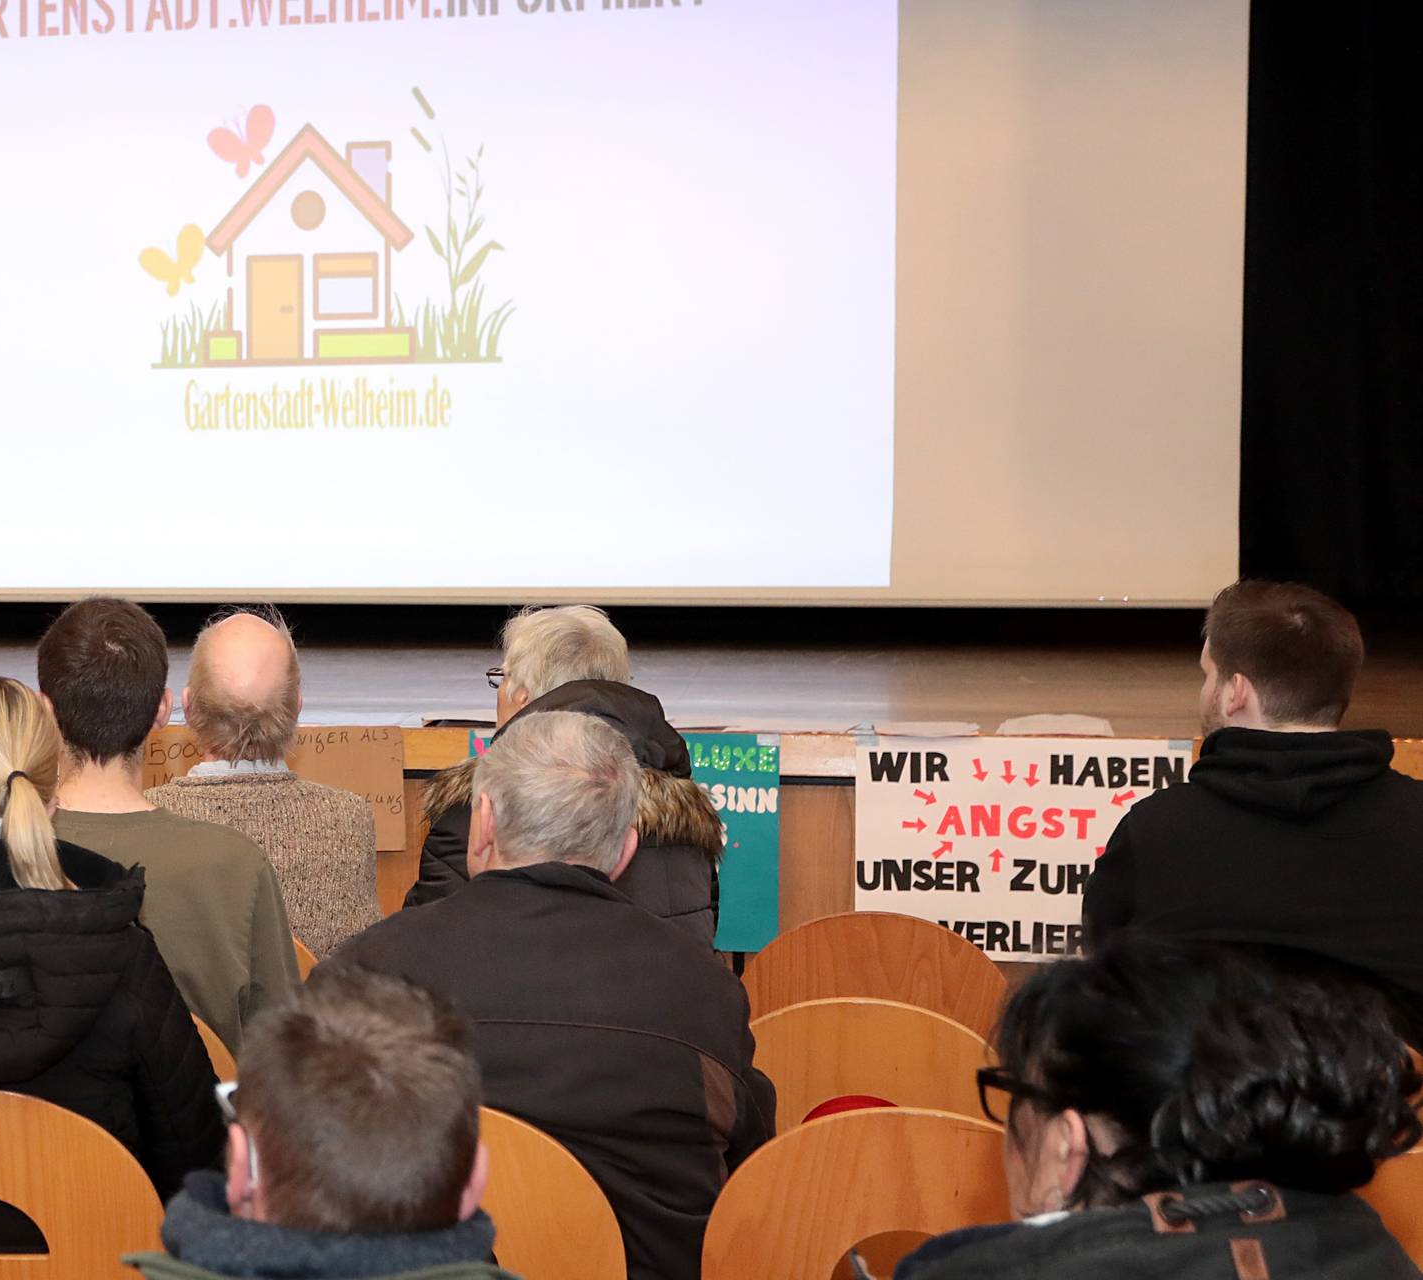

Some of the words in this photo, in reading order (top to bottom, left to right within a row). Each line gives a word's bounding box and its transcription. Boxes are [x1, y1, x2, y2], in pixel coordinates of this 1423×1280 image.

[184, 375, 452, 432] Gartenstadt-Welheim.de
[360, 728, 390, 742] ALS
[686, 742, 777, 773] LUXE
[869, 751, 950, 784] WIR
[1050, 754, 1185, 789] HABEN
[698, 783, 778, 814] SINN
[936, 804, 1097, 840] ANGST
[856, 858, 981, 893] UNSER
[1009, 859, 1091, 895] ZUH
